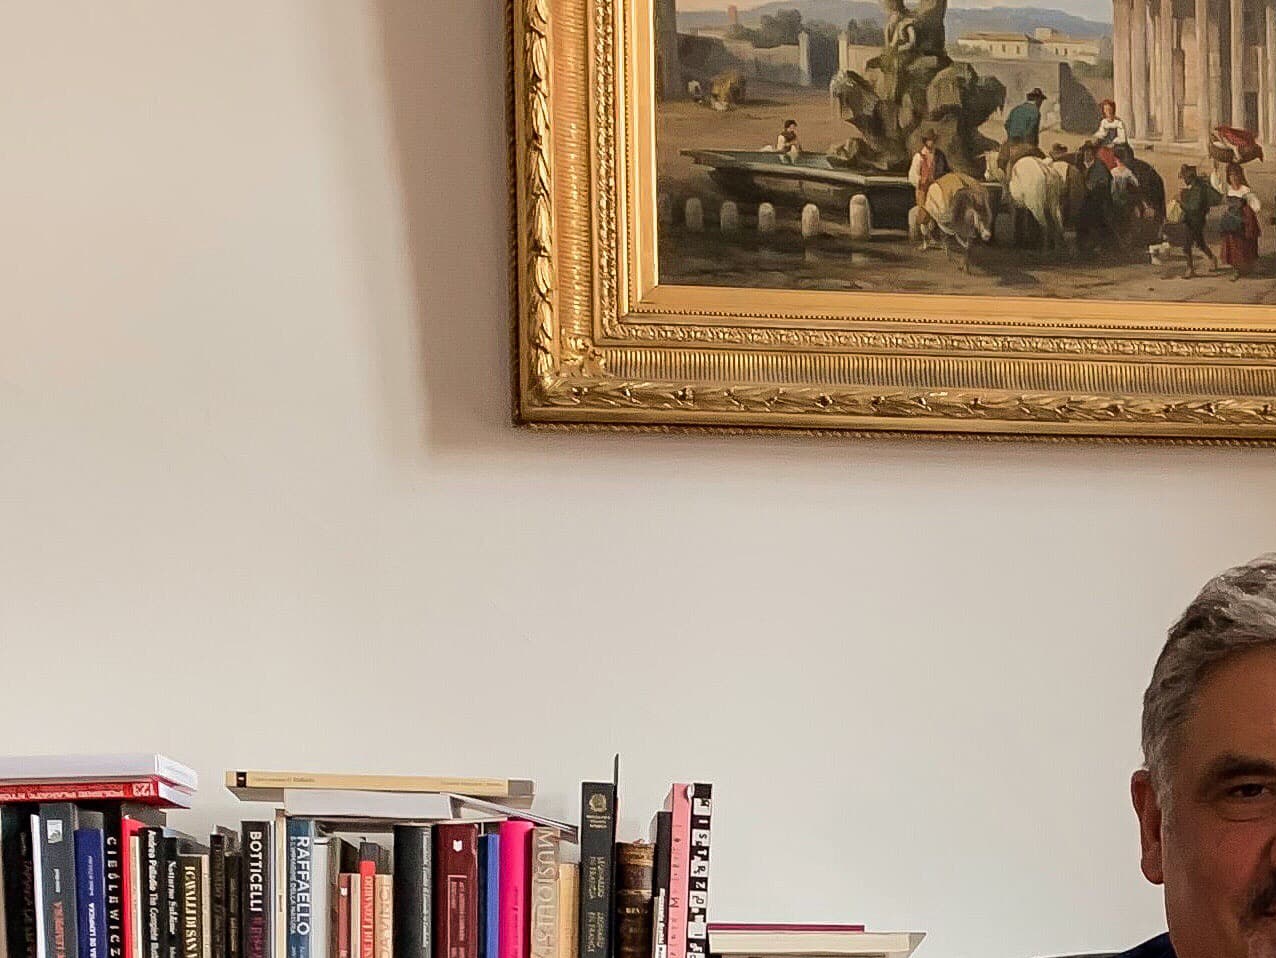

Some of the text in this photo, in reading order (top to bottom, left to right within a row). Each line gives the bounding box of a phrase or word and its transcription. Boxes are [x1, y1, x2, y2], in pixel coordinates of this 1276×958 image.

[147, 829, 157, 858] Andrea
[148, 860, 157, 891] Palladio
[167, 861, 176, 900] Notturno
[249, 831, 262, 911] BOTTICELLI
[297, 836, 310, 935] RAFFAELLO
[150, 893, 158, 906] The
[185, 870, 197, 914] CAVALLI
[362, 876, 373, 929] LEONARDO
[380, 883, 391, 934] VINCI
[149, 907, 159, 941] Complete
[186, 916, 197, 929] DI
[186, 929, 197, 951] SAN
